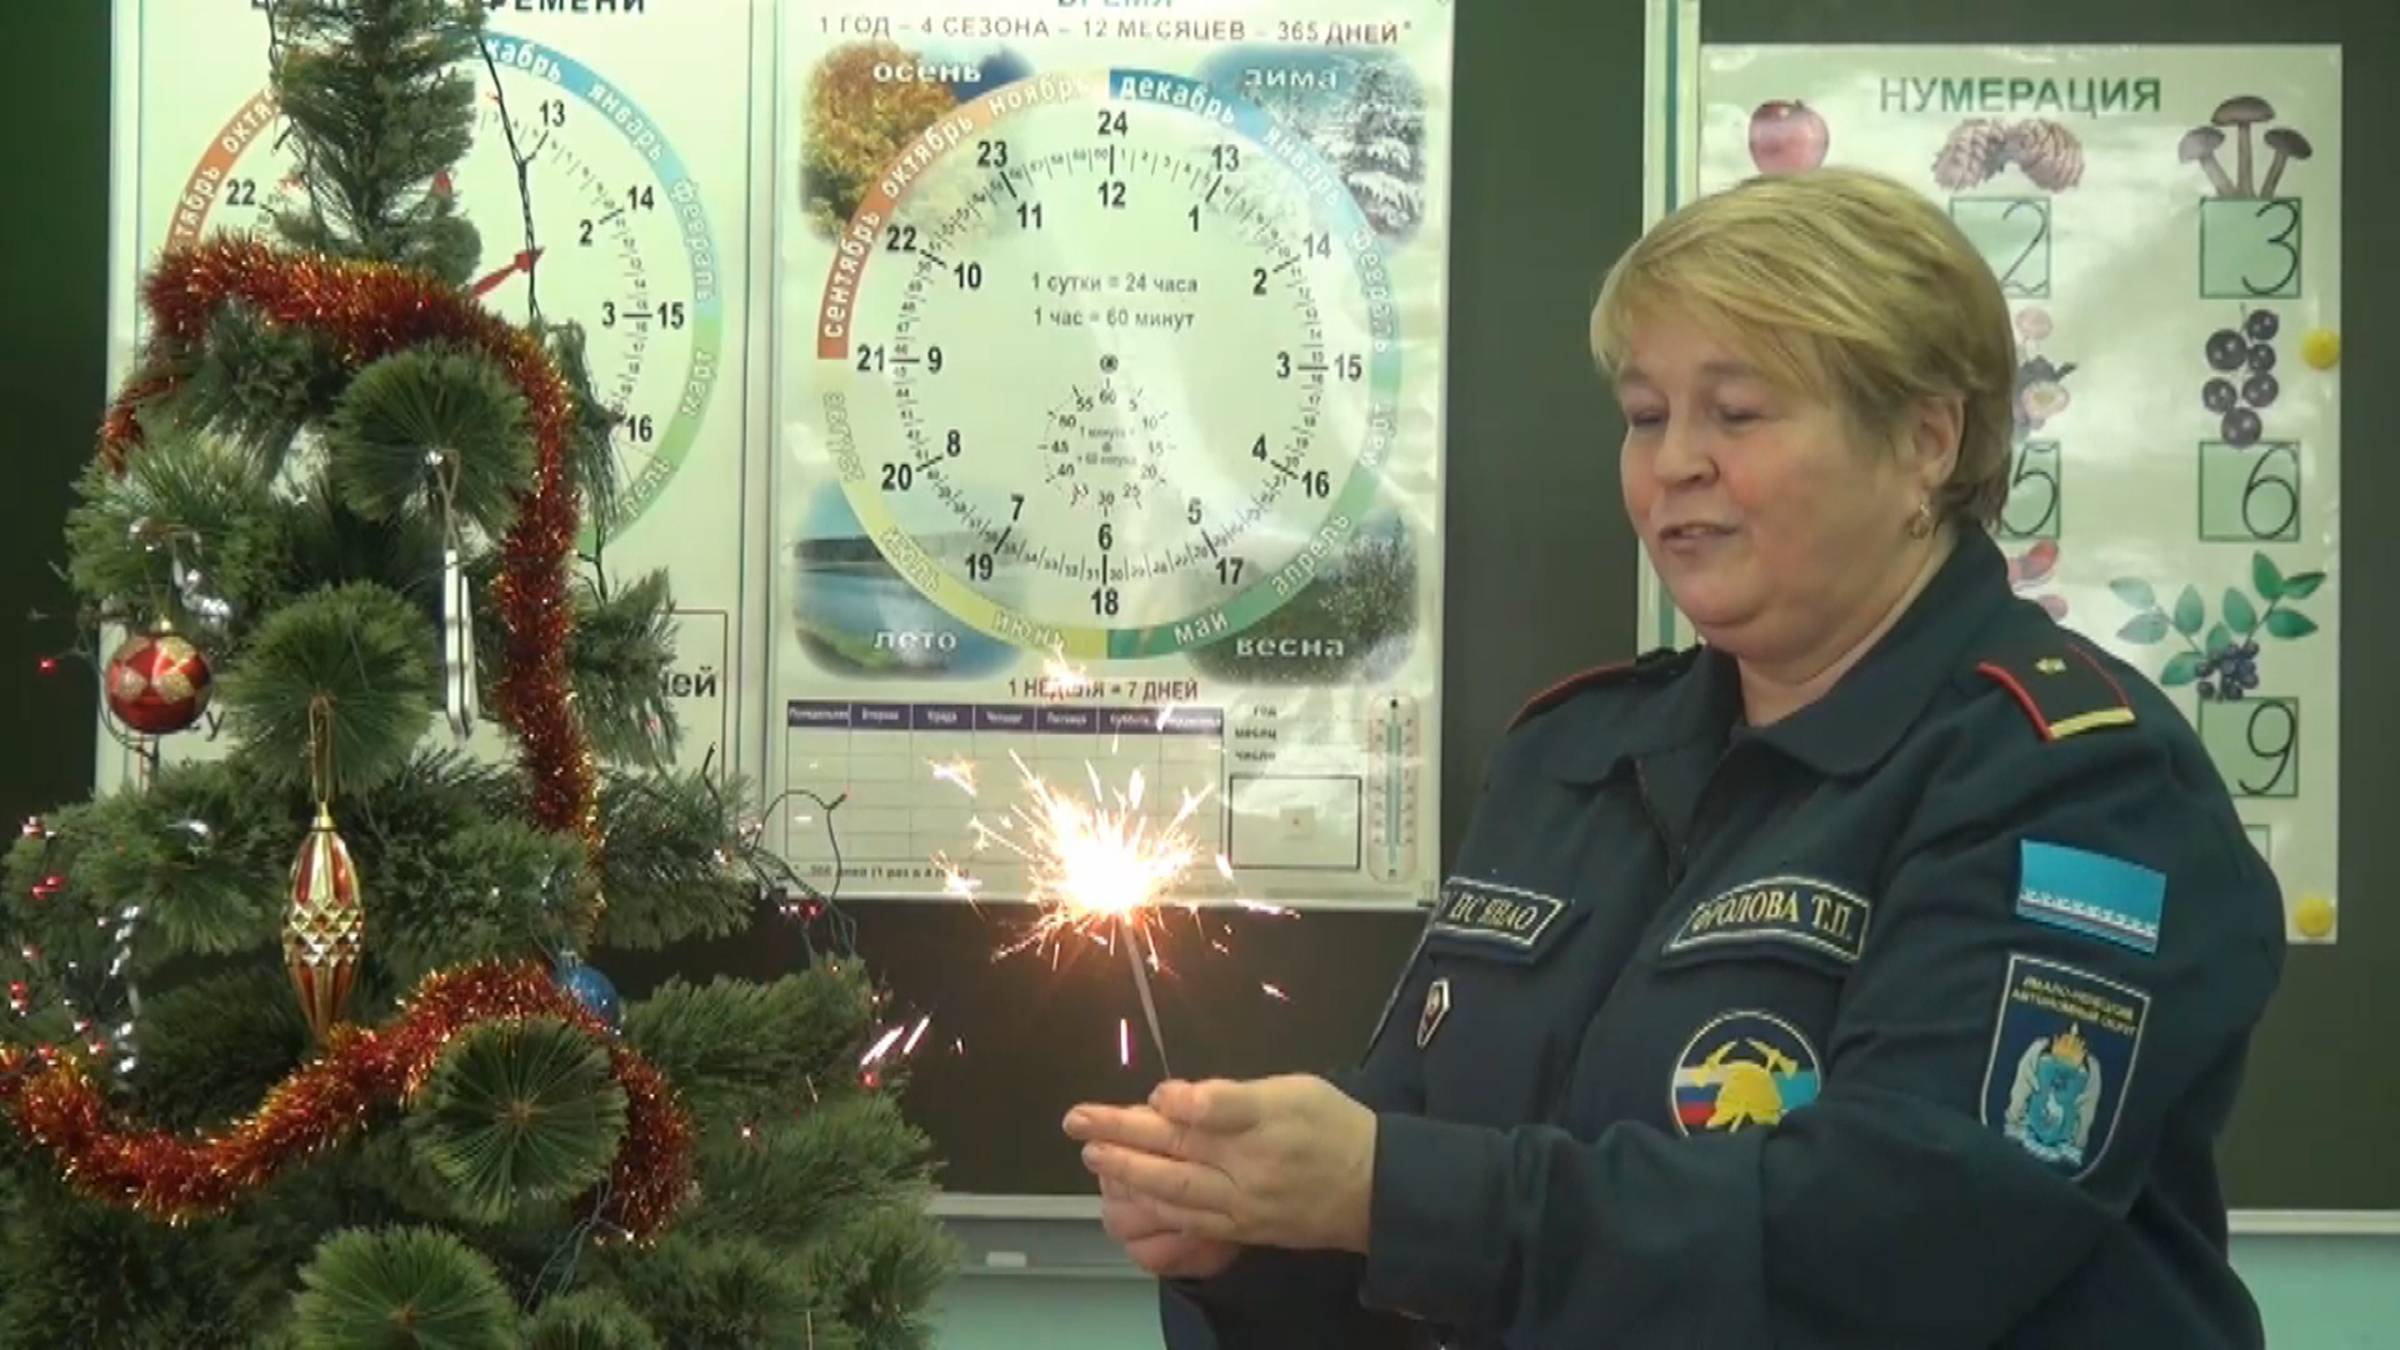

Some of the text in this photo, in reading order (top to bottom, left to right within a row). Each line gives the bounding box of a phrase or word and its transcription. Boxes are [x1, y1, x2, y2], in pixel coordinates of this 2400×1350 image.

[839, 15, 891, 39] ГОД
[920, 16, 933, 35] 4
[942, 16, 1050, 38] СЕЗОНА
[1083, 17, 1108, 38] 12
[1117, 19, 1246, 42] МЕСЯЦЕВ
[1277, 20, 1319, 42] 365
[872, 61, 981, 83] осень
[1244, 67, 1337, 90] зима
[988, 71, 1090, 119] ноябрь
[1119, 73, 1236, 124] декабрь
[1878, 77, 2162, 119] НУМЕРАЦИЯ
[538, 98, 566, 128] 13
[587, 83, 664, 161] январь
[1097, 109, 1129, 139] 24
[882, 114, 974, 198] октябрь
[976, 138, 1009, 168] 23
[1211, 143, 1240, 173] 13
[225, 178, 256, 206] 22
[627, 184, 655, 213] 14
[1097, 179, 1127, 208] 12
[1016, 200, 1043, 230] 11
[1188, 203, 1200, 232] 1
[577, 218, 593, 247] 2
[670, 179, 714, 303] февраль
[886, 223, 918, 253] 22
[1302, 231, 1332, 260] 14
[2001, 199, 2048, 295] 2
[2240, 199, 2299, 296] 3
[822, 210, 881, 339] сентябрь
[953, 259, 983, 291] 10
[1032, 271, 1040, 291] 1
[1046, 274, 1103, 296] сутки
[1125, 271, 1147, 293] 24
[1152, 277, 1199, 294] часа
[1252, 266, 1268, 297] 2
[601, 300, 616, 329] 3
[657, 300, 684, 330] 15
[1033, 305, 1042, 327] 1
[1049, 310, 1084, 328] час
[1106, 306, 1129, 328] 60
[1135, 310, 1197, 329] минут
[856, 343, 886, 373] 21
[926, 345, 943, 375] 9
[1276, 350, 1291, 381] 3
[1334, 352, 1363, 383] 15
[626, 414, 653, 443] 16
[945, 428, 961, 458] 8
[1251, 433, 1268, 462] 4
[881, 462, 913, 492] 20
[1301, 469, 1331, 499] 16
[2002, 443, 2058, 539] 5
[2241, 442, 2299, 541] 6
[1010, 492, 1025, 523] 7
[1187, 496, 1203, 525] 5
[1098, 523, 1113, 551] 6
[964, 553, 994, 582] 19
[1271, 513, 1350, 598] апрель
[1216, 557, 1244, 586] 17
[1091, 586, 1120, 616] 18
[873, 628, 957, 650] лето
[1173, 604, 1229, 646] май
[1236, 637, 1345, 658] весна
[1008, 678, 1017, 697] 1
[1125, 680, 1138, 698] 7
[1142, 678, 1199, 703] ДНЕЙ
[2238, 700, 2297, 796] 9
